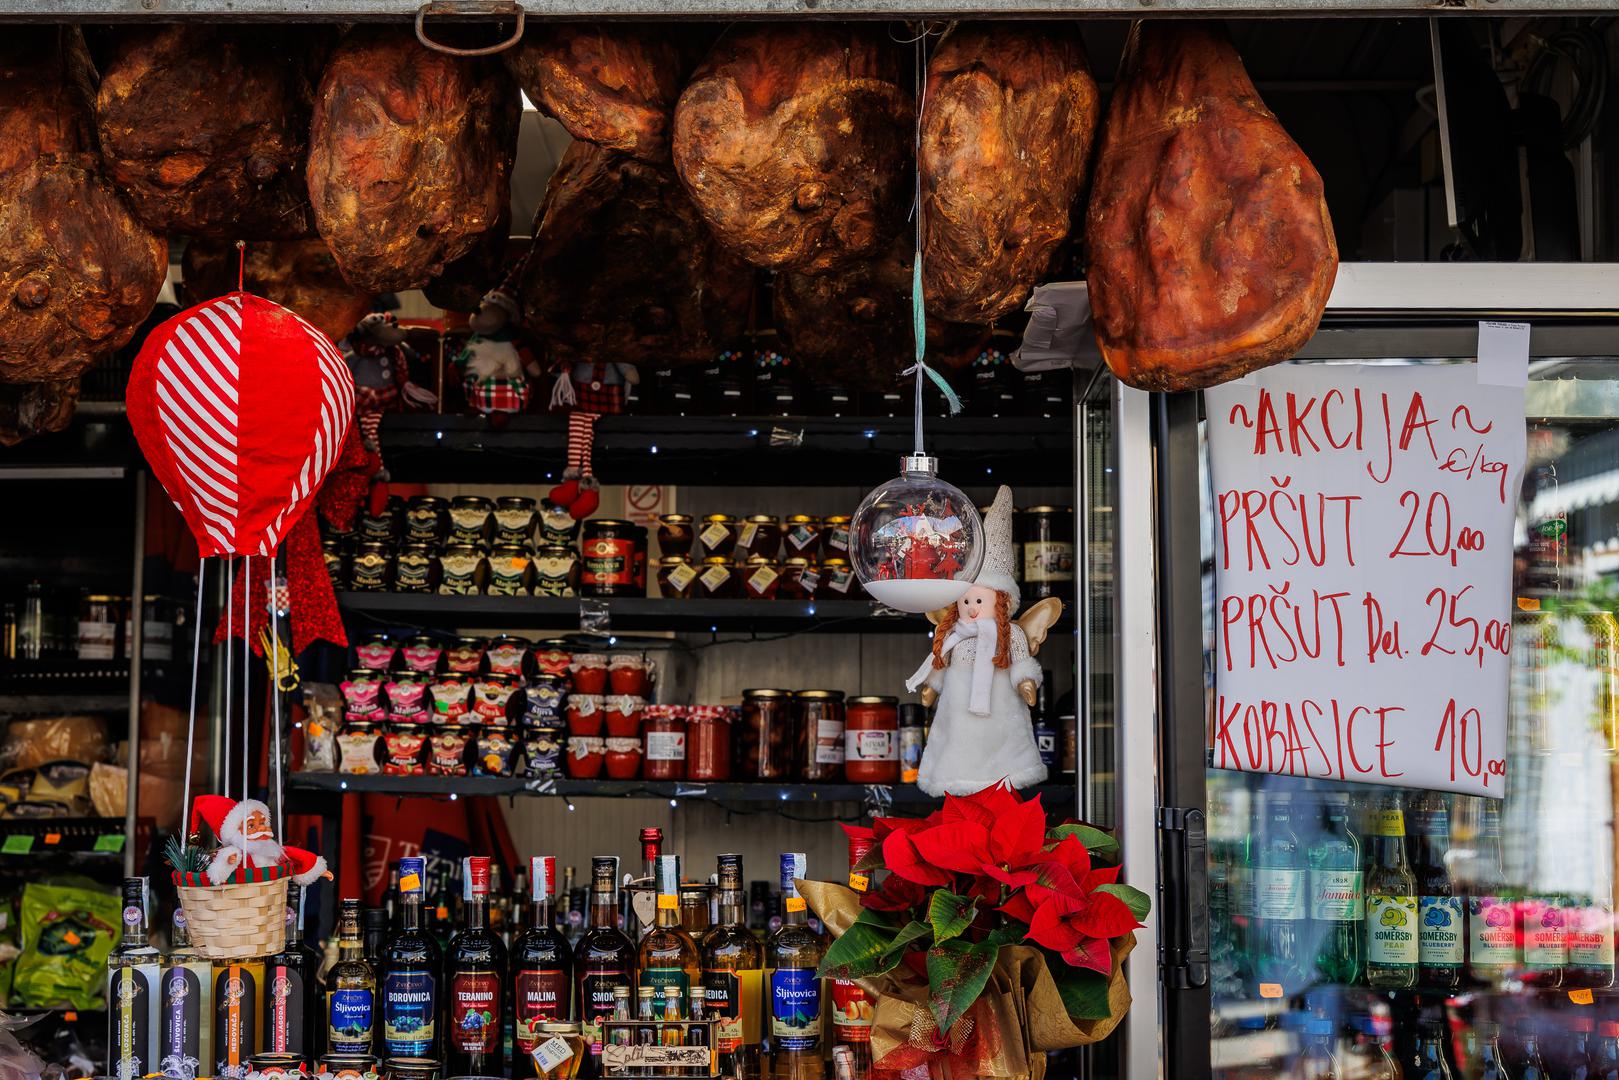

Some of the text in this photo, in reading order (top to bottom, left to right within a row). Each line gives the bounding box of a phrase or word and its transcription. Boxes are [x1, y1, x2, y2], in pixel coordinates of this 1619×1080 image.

[1219, 476, 1485, 572] PRŠUT 20,00
[1222, 581, 1351, 671] PRŠUT
[1421, 585, 1511, 668] 25,00
[350, 703, 378, 713] Malina
[393, 705, 421, 714] Malina
[1217, 696, 1506, 787] KOBASICE 10,00
[1374, 931, 1413, 941] SOMERSBY
[1419, 931, 1458, 941] SOMERSBY
[388, 991, 431, 1003] BOROVNICA
[458, 991, 493, 1001] TERANINO
[527, 991, 556, 1002] MALINA
[776, 985, 817, 1000] Šljivovica
[335, 1001, 371, 1014] Šljivovica
[122, 1014, 130, 1052] LOZOVAČA
[174, 1009, 182, 1053] ŠLJIVOVICA
[230, 1013, 238, 1053] MEDOVAČA
[606, 1042, 651, 1072] Split
